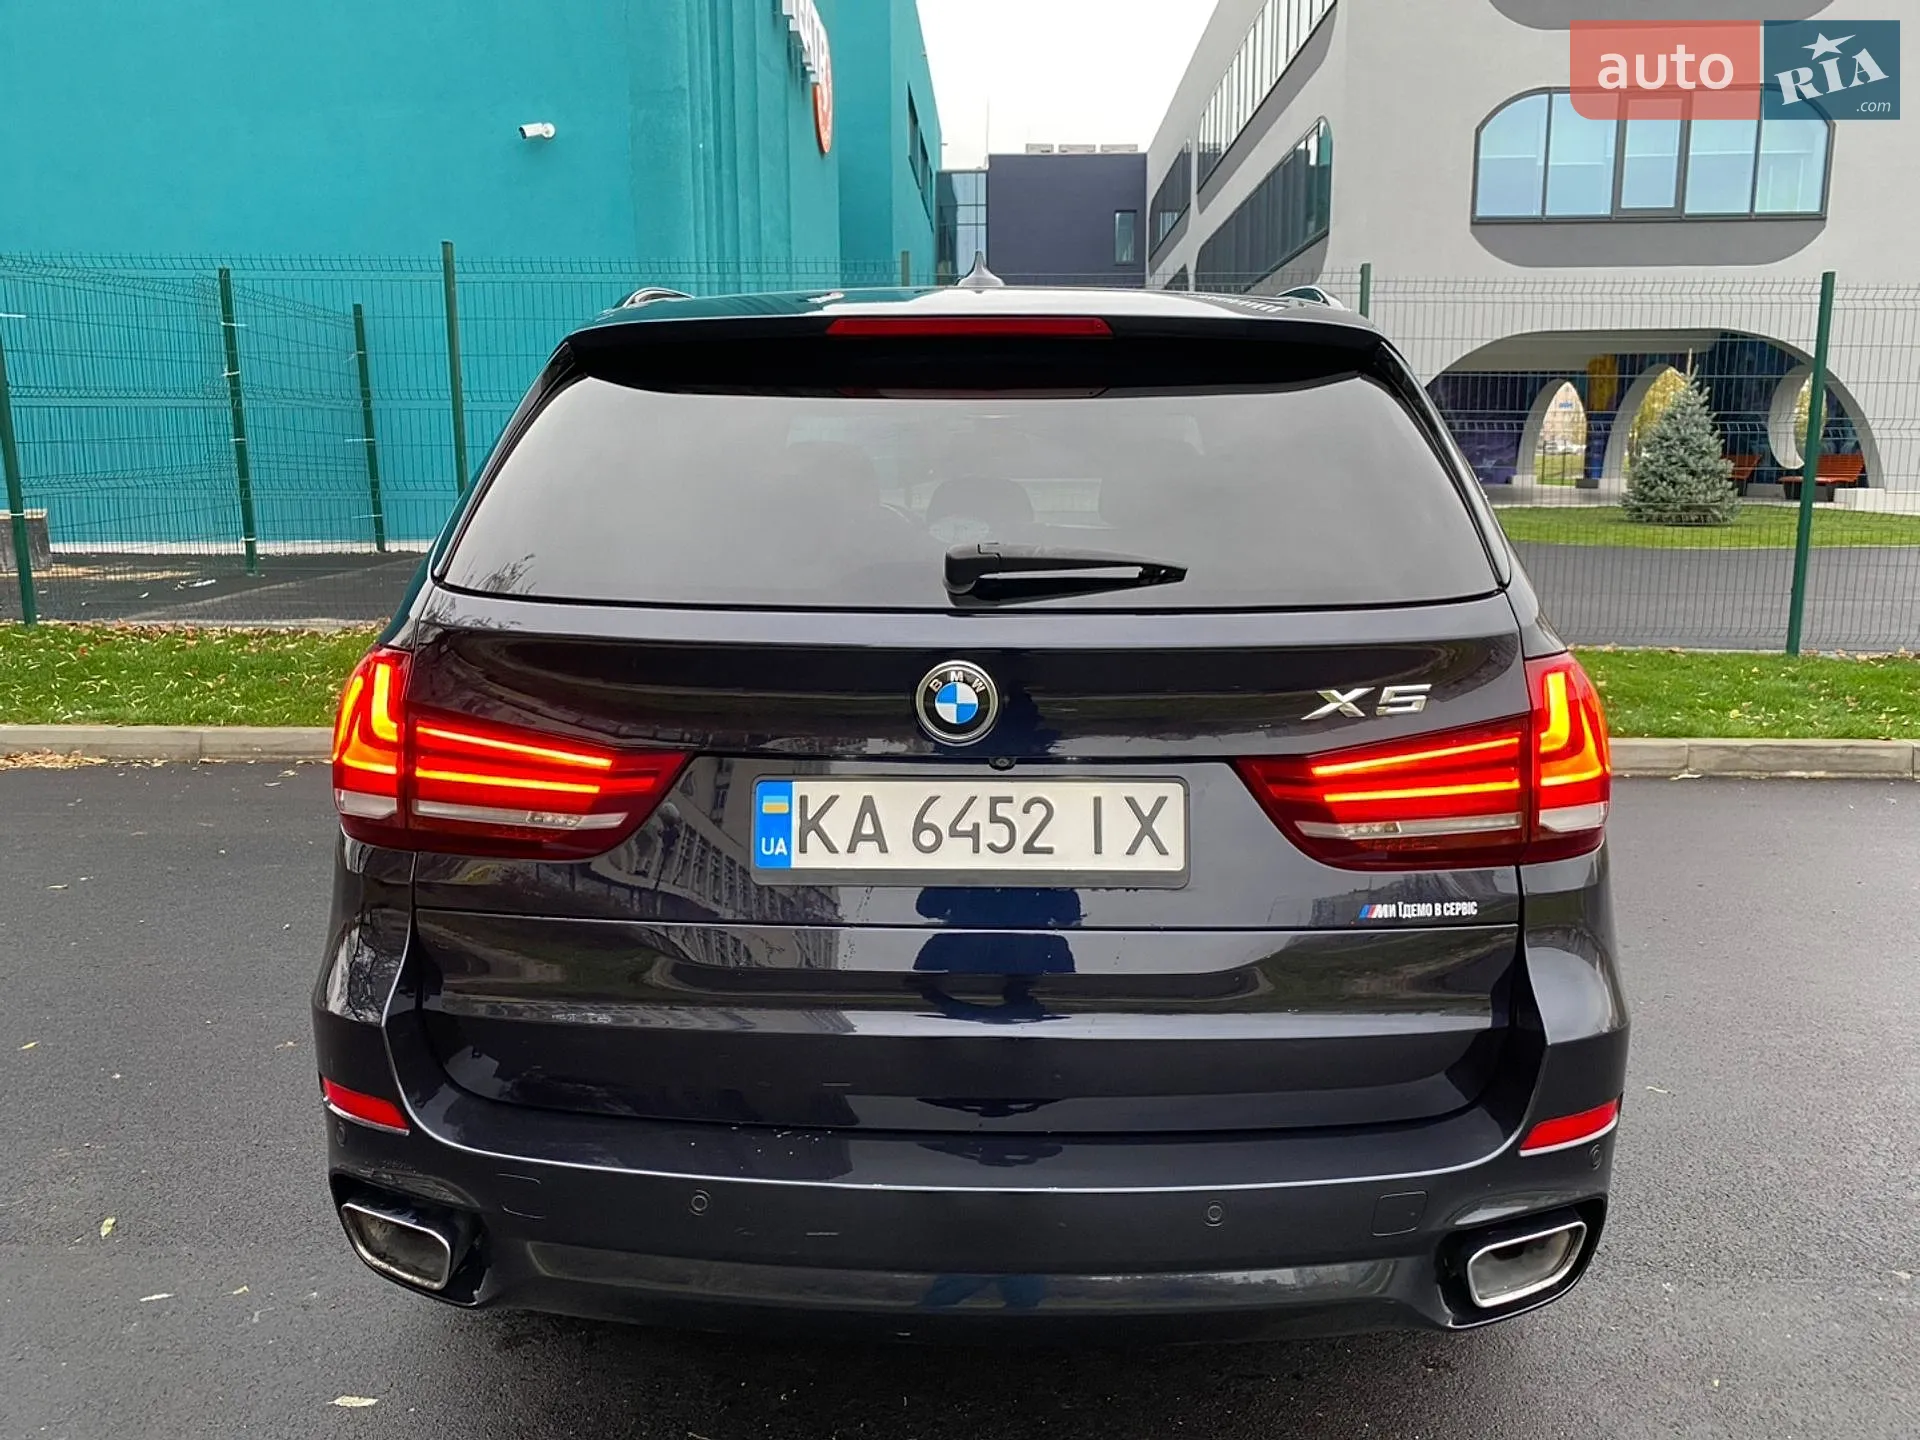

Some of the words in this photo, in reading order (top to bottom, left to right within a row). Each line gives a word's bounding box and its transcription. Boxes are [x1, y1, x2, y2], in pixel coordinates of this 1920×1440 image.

[929, 671, 986, 693] BMW
[1300, 684, 1433, 717] X5
[799, 795, 888, 854] KA
[912, 795, 1055, 855] 6452
[1093, 795, 1170, 856] IX
[761, 838, 788, 856] UA
[1434, 903, 1442, 916] В
[1443, 901, 1478, 916] СЕРВІС
